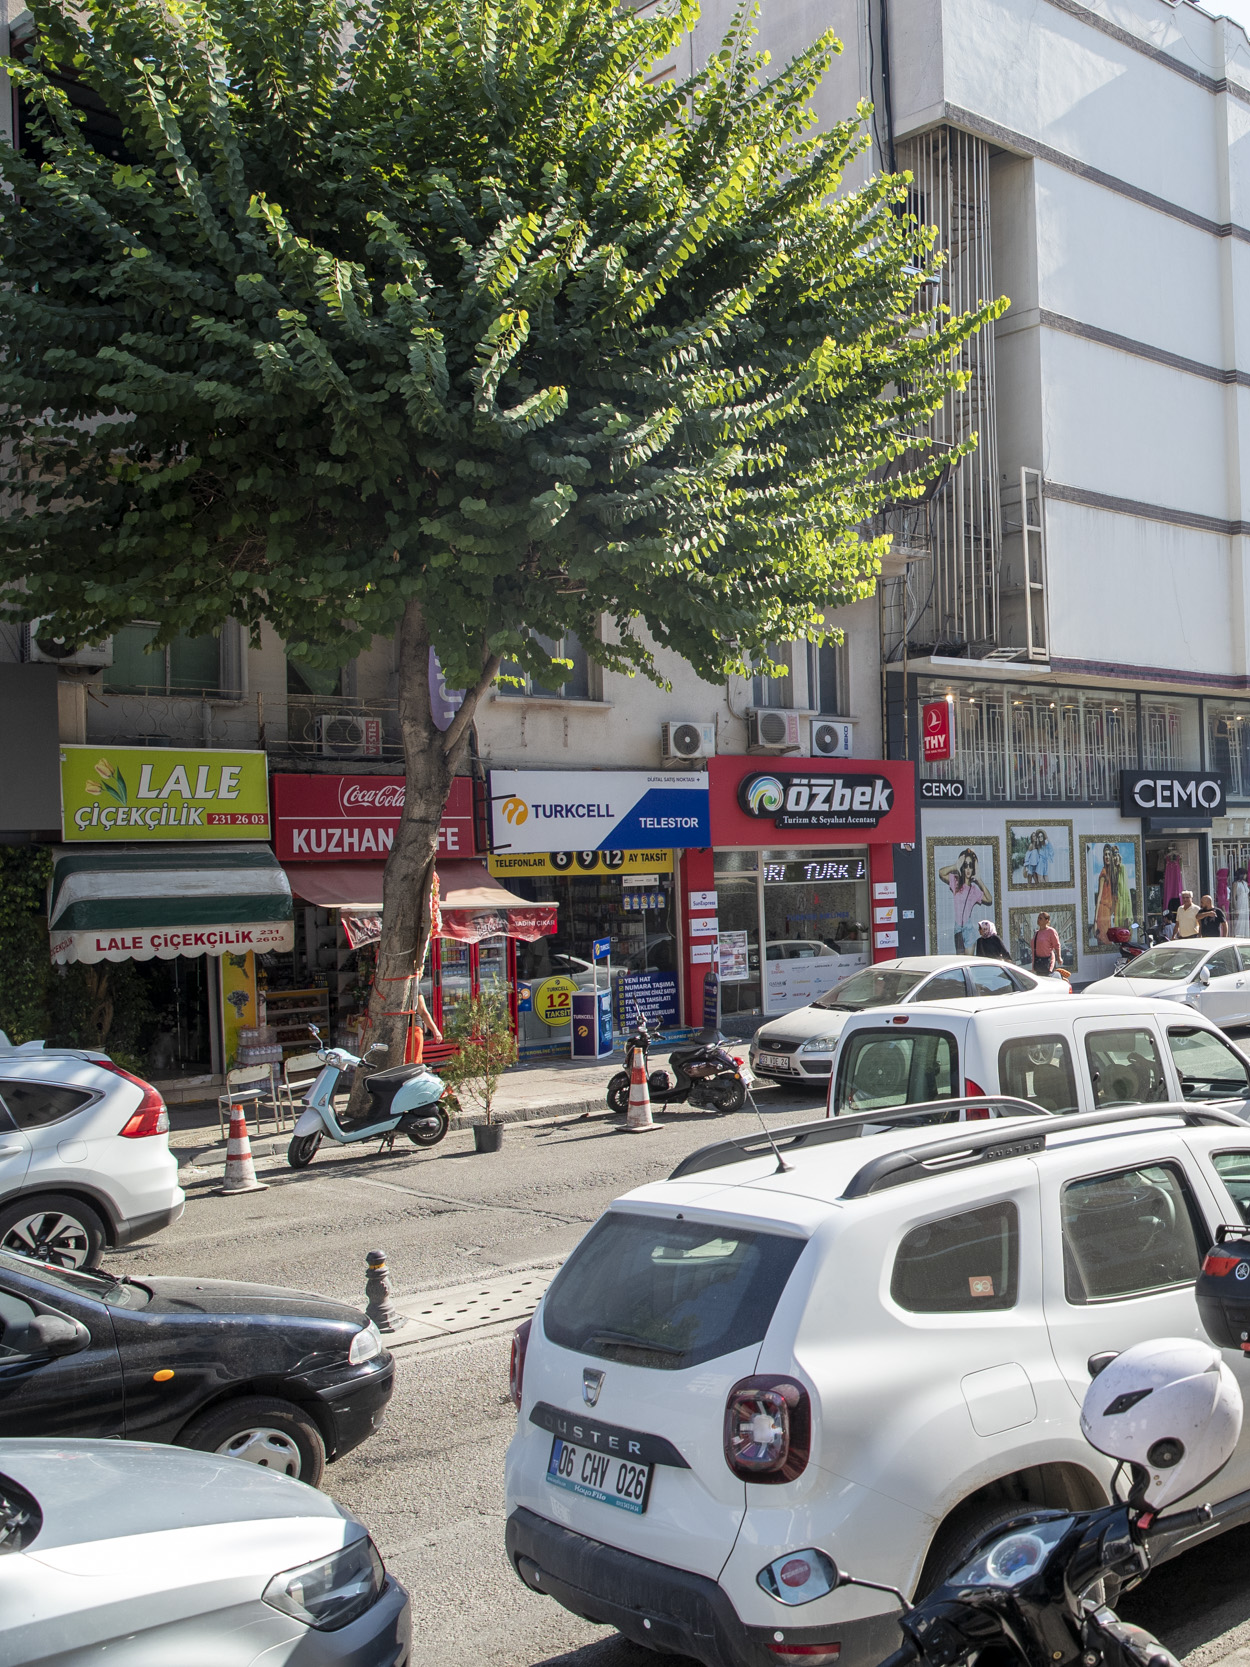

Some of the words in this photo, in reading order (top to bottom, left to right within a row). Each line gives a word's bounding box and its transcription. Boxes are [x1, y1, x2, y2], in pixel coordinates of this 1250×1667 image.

[924, 734, 946, 749] THY
[136, 764, 242, 800] LALE
[923, 783, 962, 796] CEMO
[1134, 779, 1220, 808] CEMO
[74, 802, 205, 831] ÇİÇEKÇİLİK
[212, 815, 231, 824] 231
[236, 814, 249, 824] 26
[251, 814, 264, 824] 03
[532, 804, 615, 818] TURKCELL
[639, 817, 699, 828] TELESTOR
[819, 816, 846, 825] Seyahat
[847, 816, 876, 825] Acentası
[293, 828, 394, 853] KUZHAN
[495, 859, 545, 868] TELEFONLARI
[557, 851, 566, 865] 6
[583, 851, 593, 865] 9
[604, 850, 622, 864] 12
[628, 854, 638, 862] AY
[641, 850, 667, 862] TAKSİT
[96, 937, 143, 951] LALE
[150, 930, 254, 951] ÇİÇEKÇİLİK
[547, 992, 569, 1008] 12
[546, 1008, 571, 1018] TAKSİT
[545, 1415, 641, 1455] DUSTER
[558, 1445, 576, 1477] 06
[581, 1453, 610, 1488] CHV
[616, 1463, 646, 1500] 026
